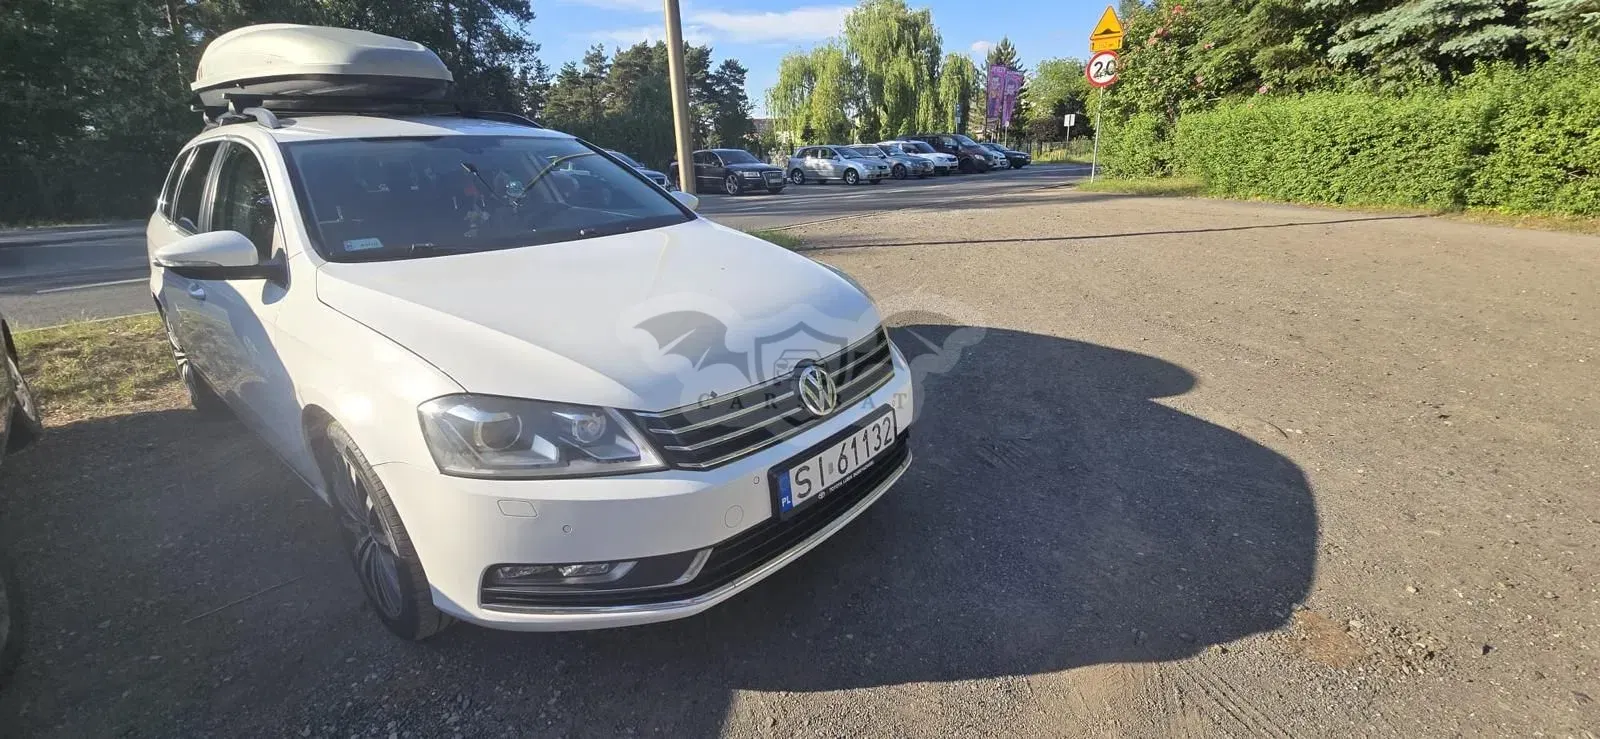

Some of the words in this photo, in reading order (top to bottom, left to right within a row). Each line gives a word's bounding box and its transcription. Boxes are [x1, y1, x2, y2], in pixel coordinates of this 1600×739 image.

[1093, 59, 1117, 79] 20
[794, 456, 825, 499] SI
[837, 416, 893, 475] 61132
[781, 496, 791, 508] PL
